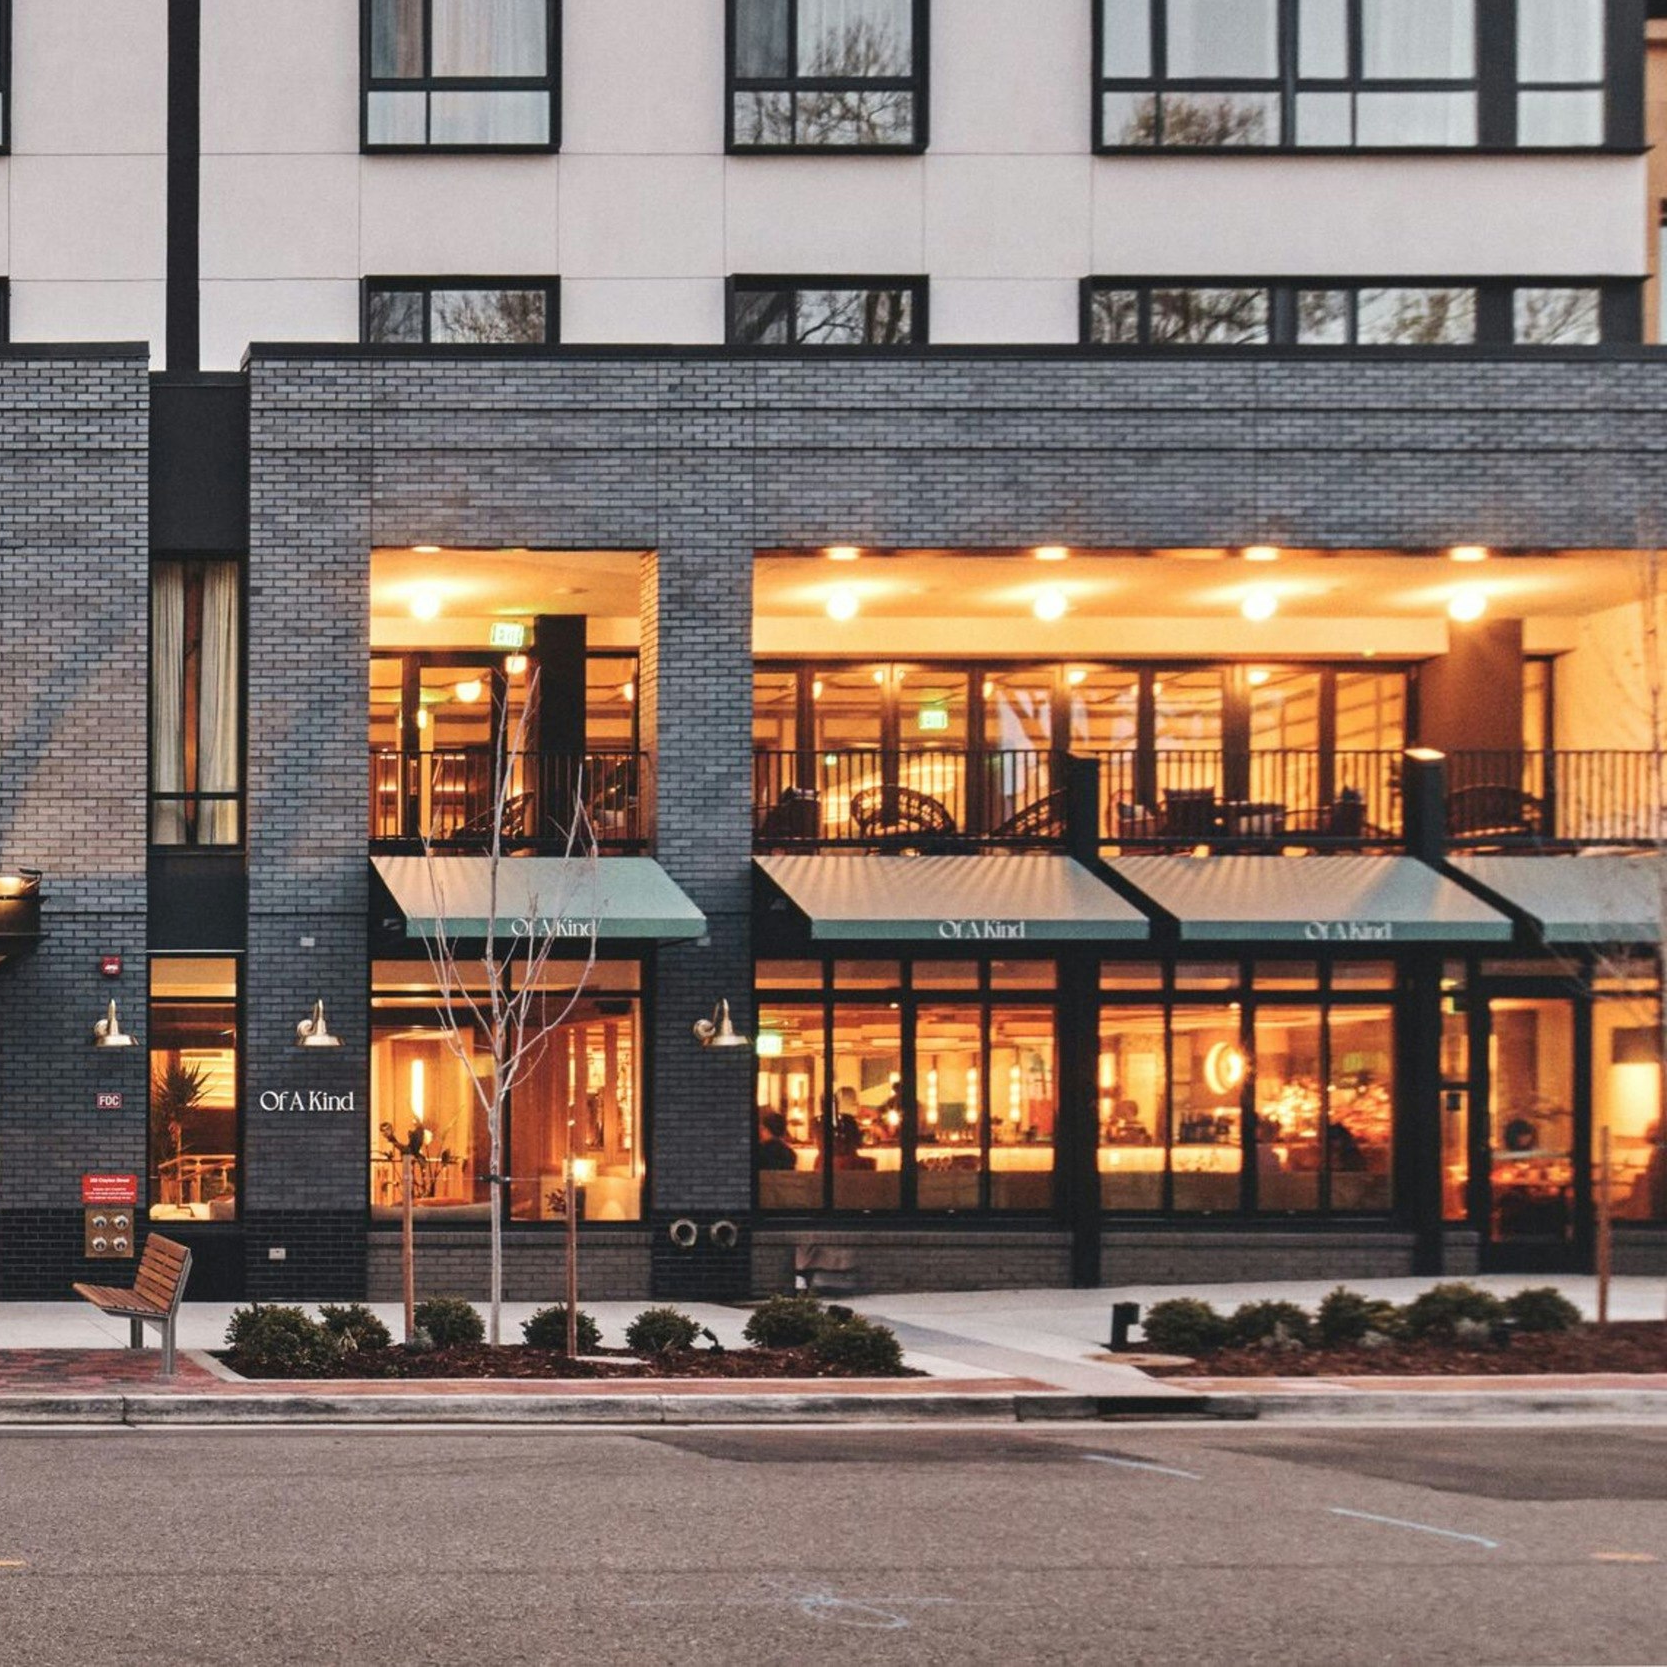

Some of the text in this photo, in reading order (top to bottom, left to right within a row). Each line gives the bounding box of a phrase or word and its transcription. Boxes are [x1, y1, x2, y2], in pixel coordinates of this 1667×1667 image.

[556, 918, 596, 936] Kind
[939, 920, 1025, 938] Of A Kind
[99, 1095, 119, 1106] FDC
[260, 1091, 355, 1111] Of A Kind
